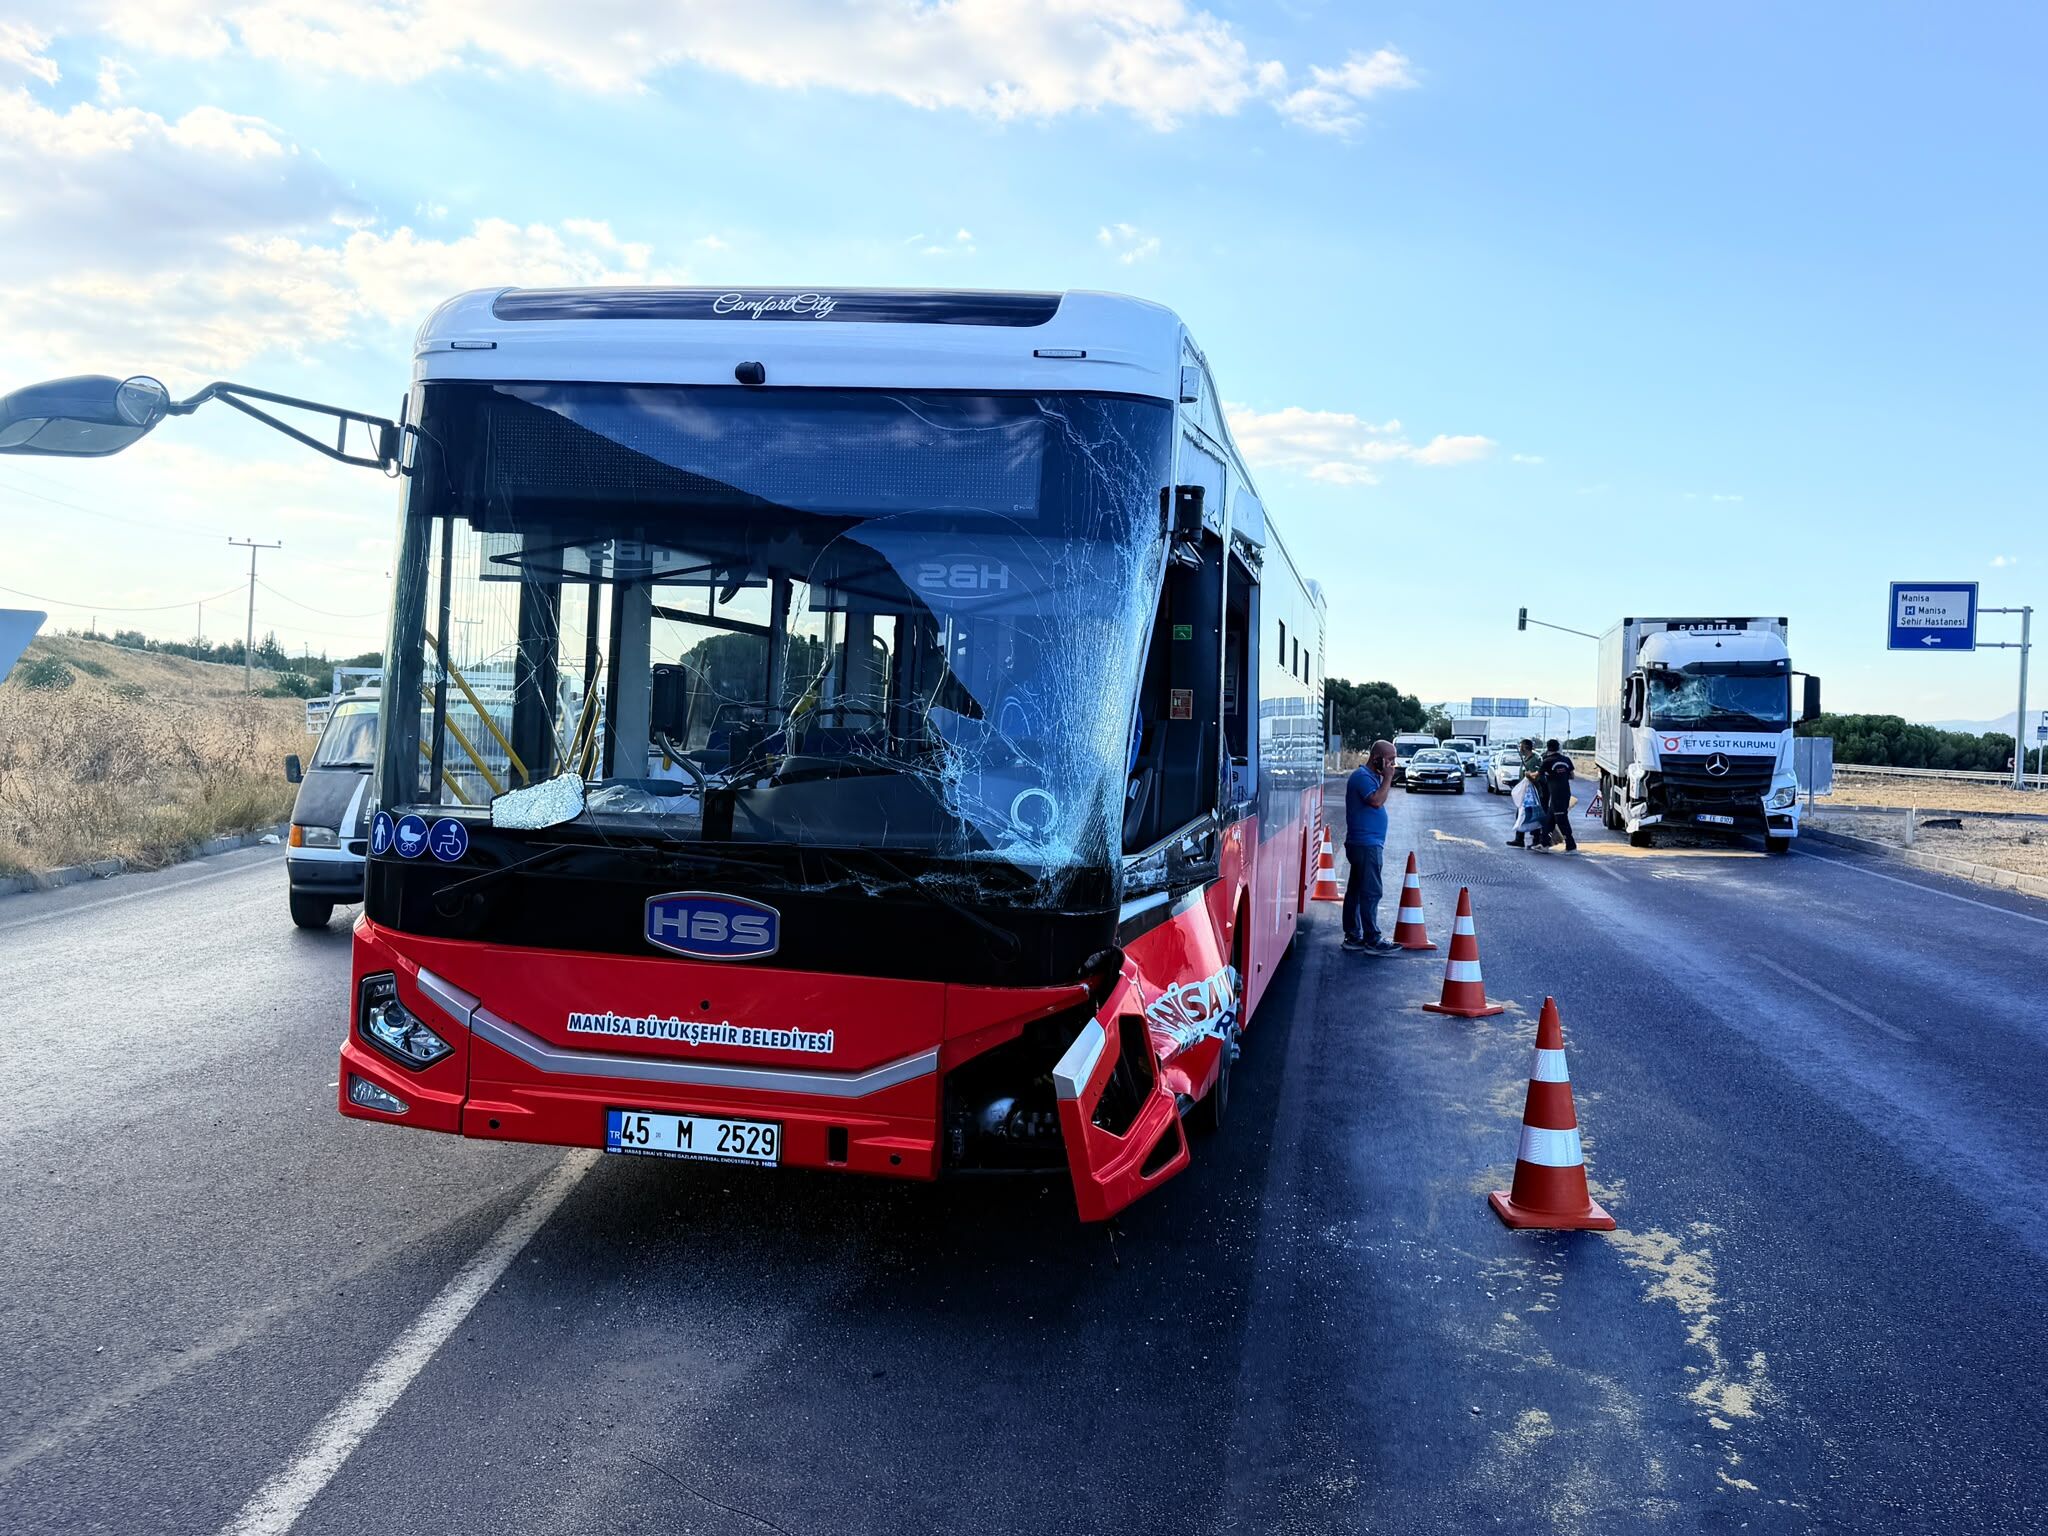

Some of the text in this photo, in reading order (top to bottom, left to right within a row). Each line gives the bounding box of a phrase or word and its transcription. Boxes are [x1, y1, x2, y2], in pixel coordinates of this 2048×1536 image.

[1901, 593, 1930, 602] Manisa
[1918, 606, 1947, 615] Manisa
[1925, 617, 1966, 626] Hastanesi
[1699, 739, 1711, 748] VE
[1733, 740, 1776, 749] KURUMU
[653, 906, 770, 946] HBS
[569, 1013, 832, 1051] MANİSA BÜYÜKŞEHİR BELEDİYESİ
[609, 1115, 775, 1156] TR 45 M 2529
